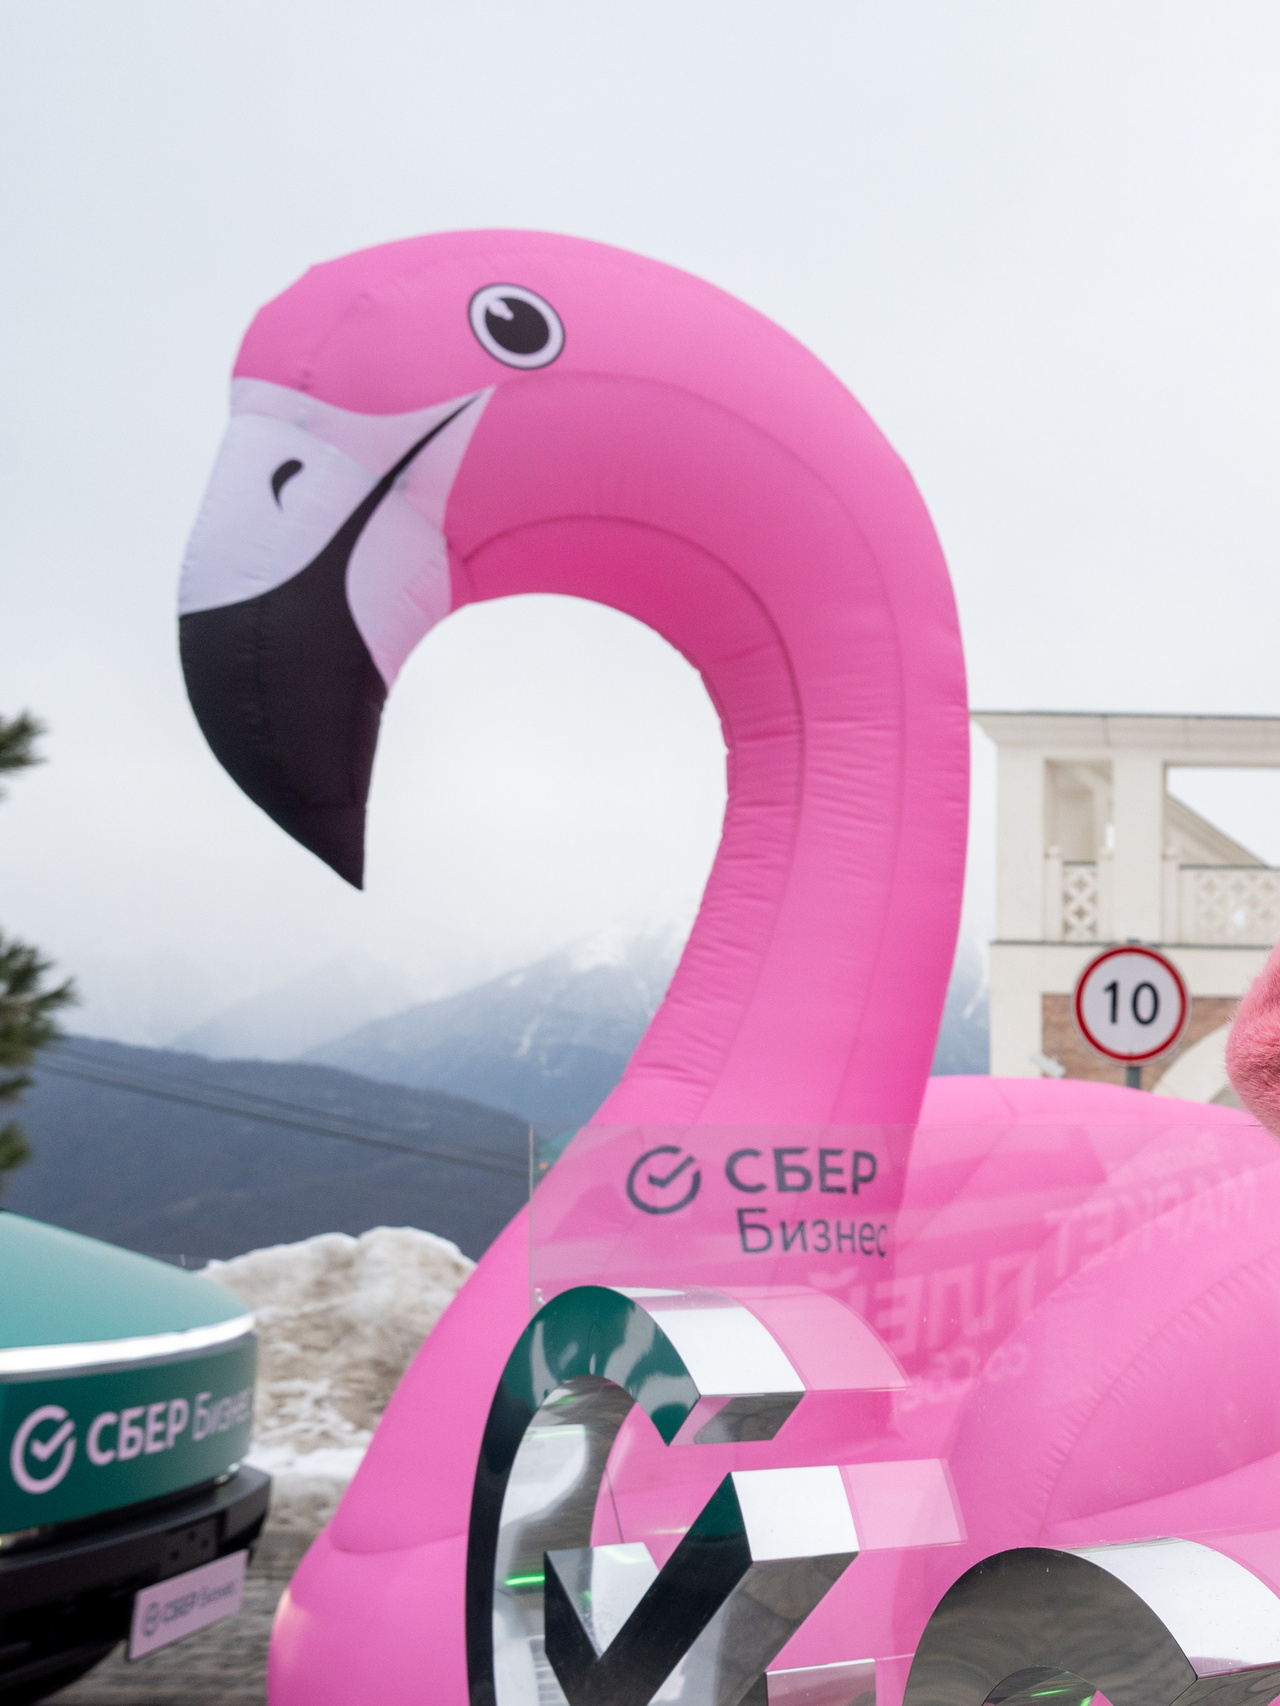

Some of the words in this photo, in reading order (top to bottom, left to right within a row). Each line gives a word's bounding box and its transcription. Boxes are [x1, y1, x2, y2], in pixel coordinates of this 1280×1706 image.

[1103, 980, 1159, 1026] 10
[724, 1147, 878, 1196] СБЕР
[736, 1207, 888, 1258] Бизнес
[86, 1397, 190, 1466] СБЕР
